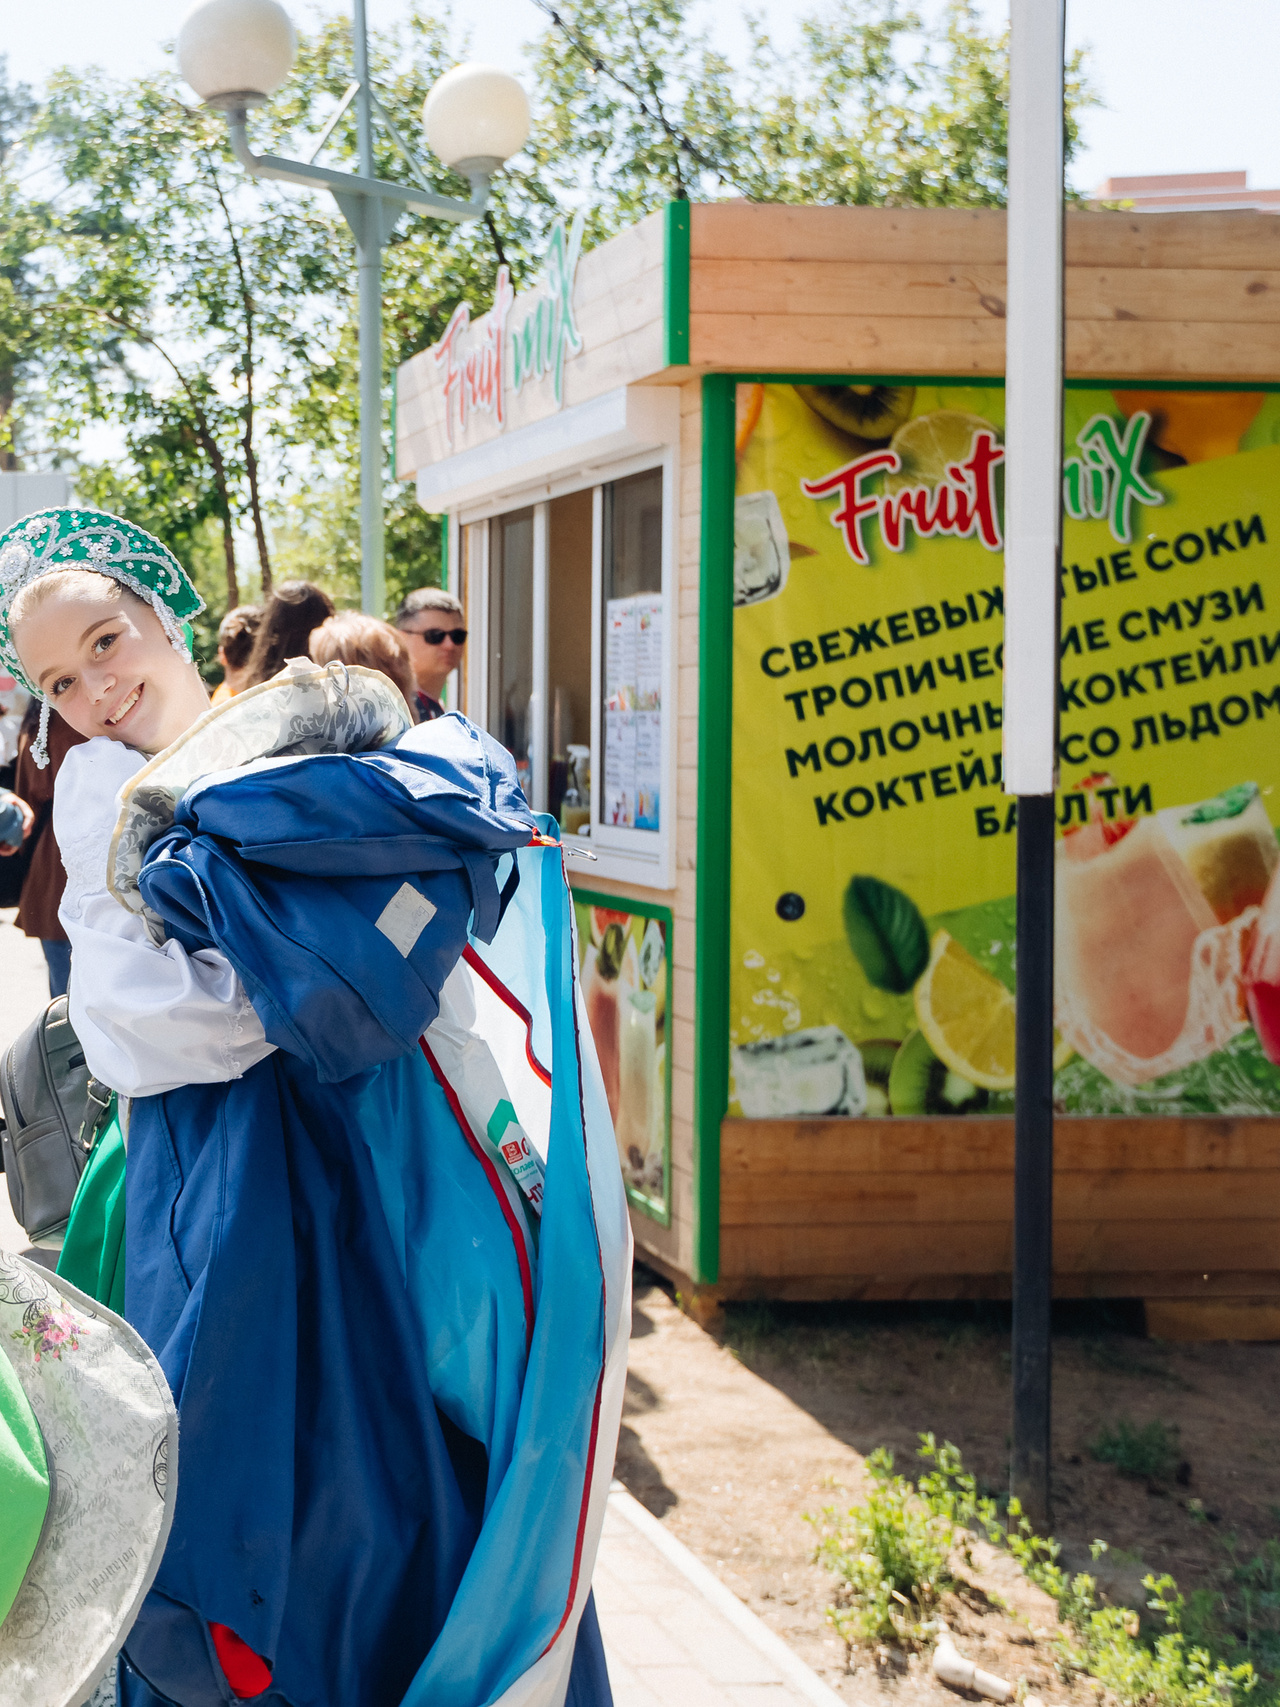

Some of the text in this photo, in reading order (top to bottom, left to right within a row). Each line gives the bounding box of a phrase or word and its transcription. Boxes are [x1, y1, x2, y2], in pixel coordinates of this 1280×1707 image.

[801, 430, 1005, 564] Fruit
[760, 551, 1138, 678] СВЕЖЕВЫЖЫЕ
[1144, 514, 1267, 572] СОКИ
[784, 582, 1265, 722] ТРОПИЧЕИЕ СМУЗИ
[784, 700, 1003, 778] МОЛОЧН
[813, 686, 1280, 826] КОКТЕЙ СО ЛЬДОМ
[1096, 783, 1153, 819] ТИ
